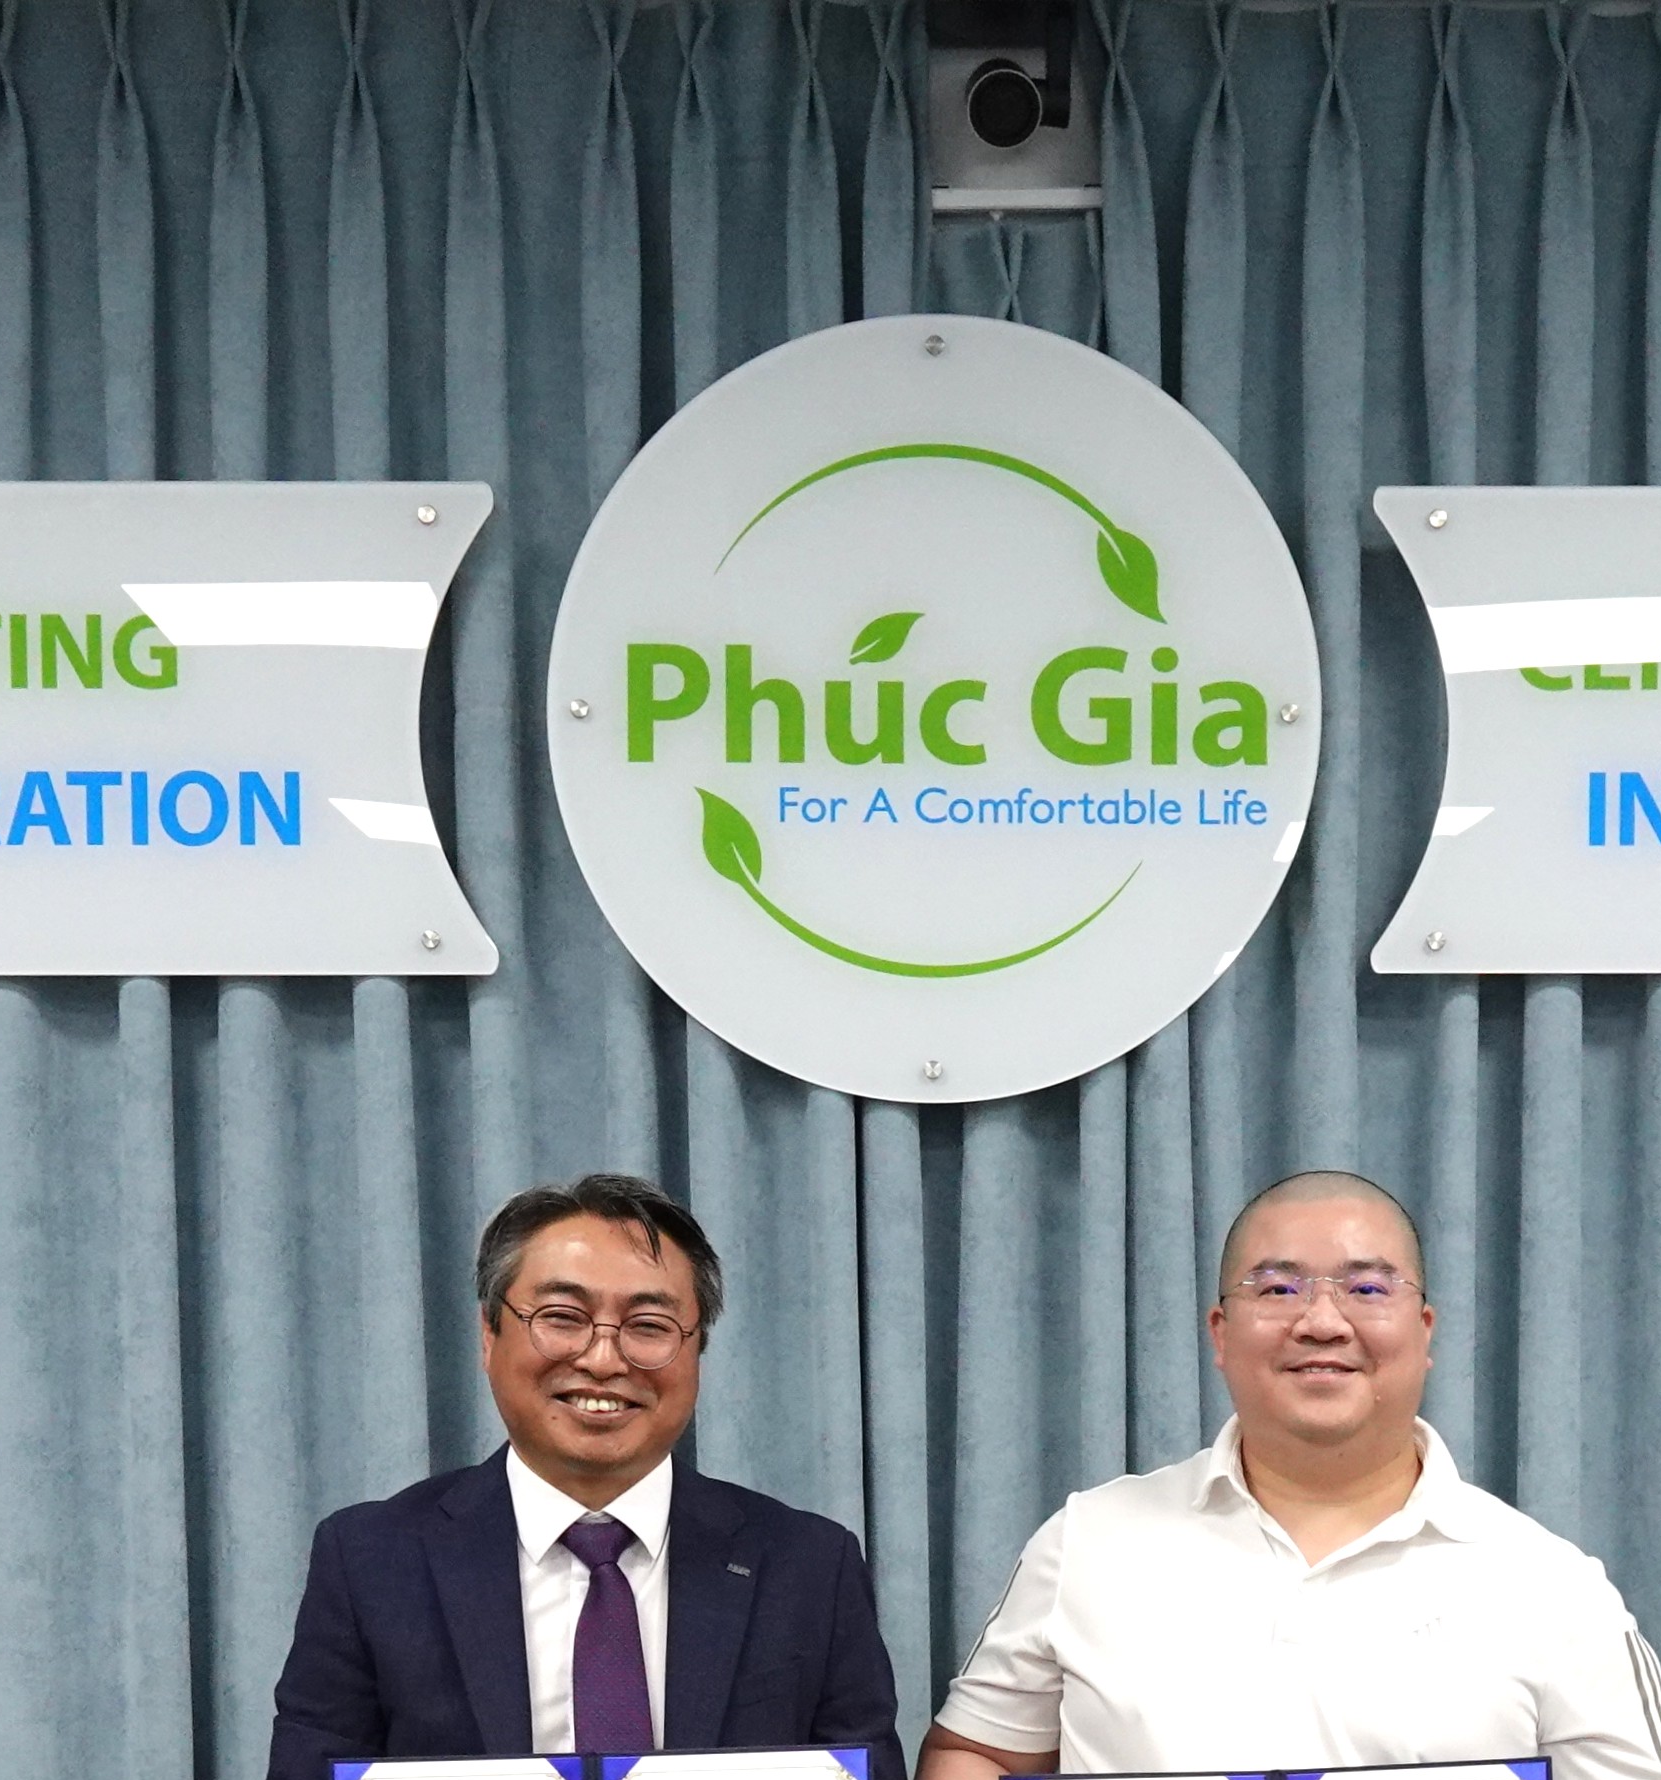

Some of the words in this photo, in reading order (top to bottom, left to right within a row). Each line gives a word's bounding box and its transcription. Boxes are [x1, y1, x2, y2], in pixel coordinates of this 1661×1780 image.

[625, 611, 987, 765] Phúc
[1029, 646, 1269, 767] Gia
[778, 786, 847, 825] For
[862, 787, 899, 825] A
[915, 787, 1183, 827] Comfortable
[1197, 788, 1269, 827] Life
